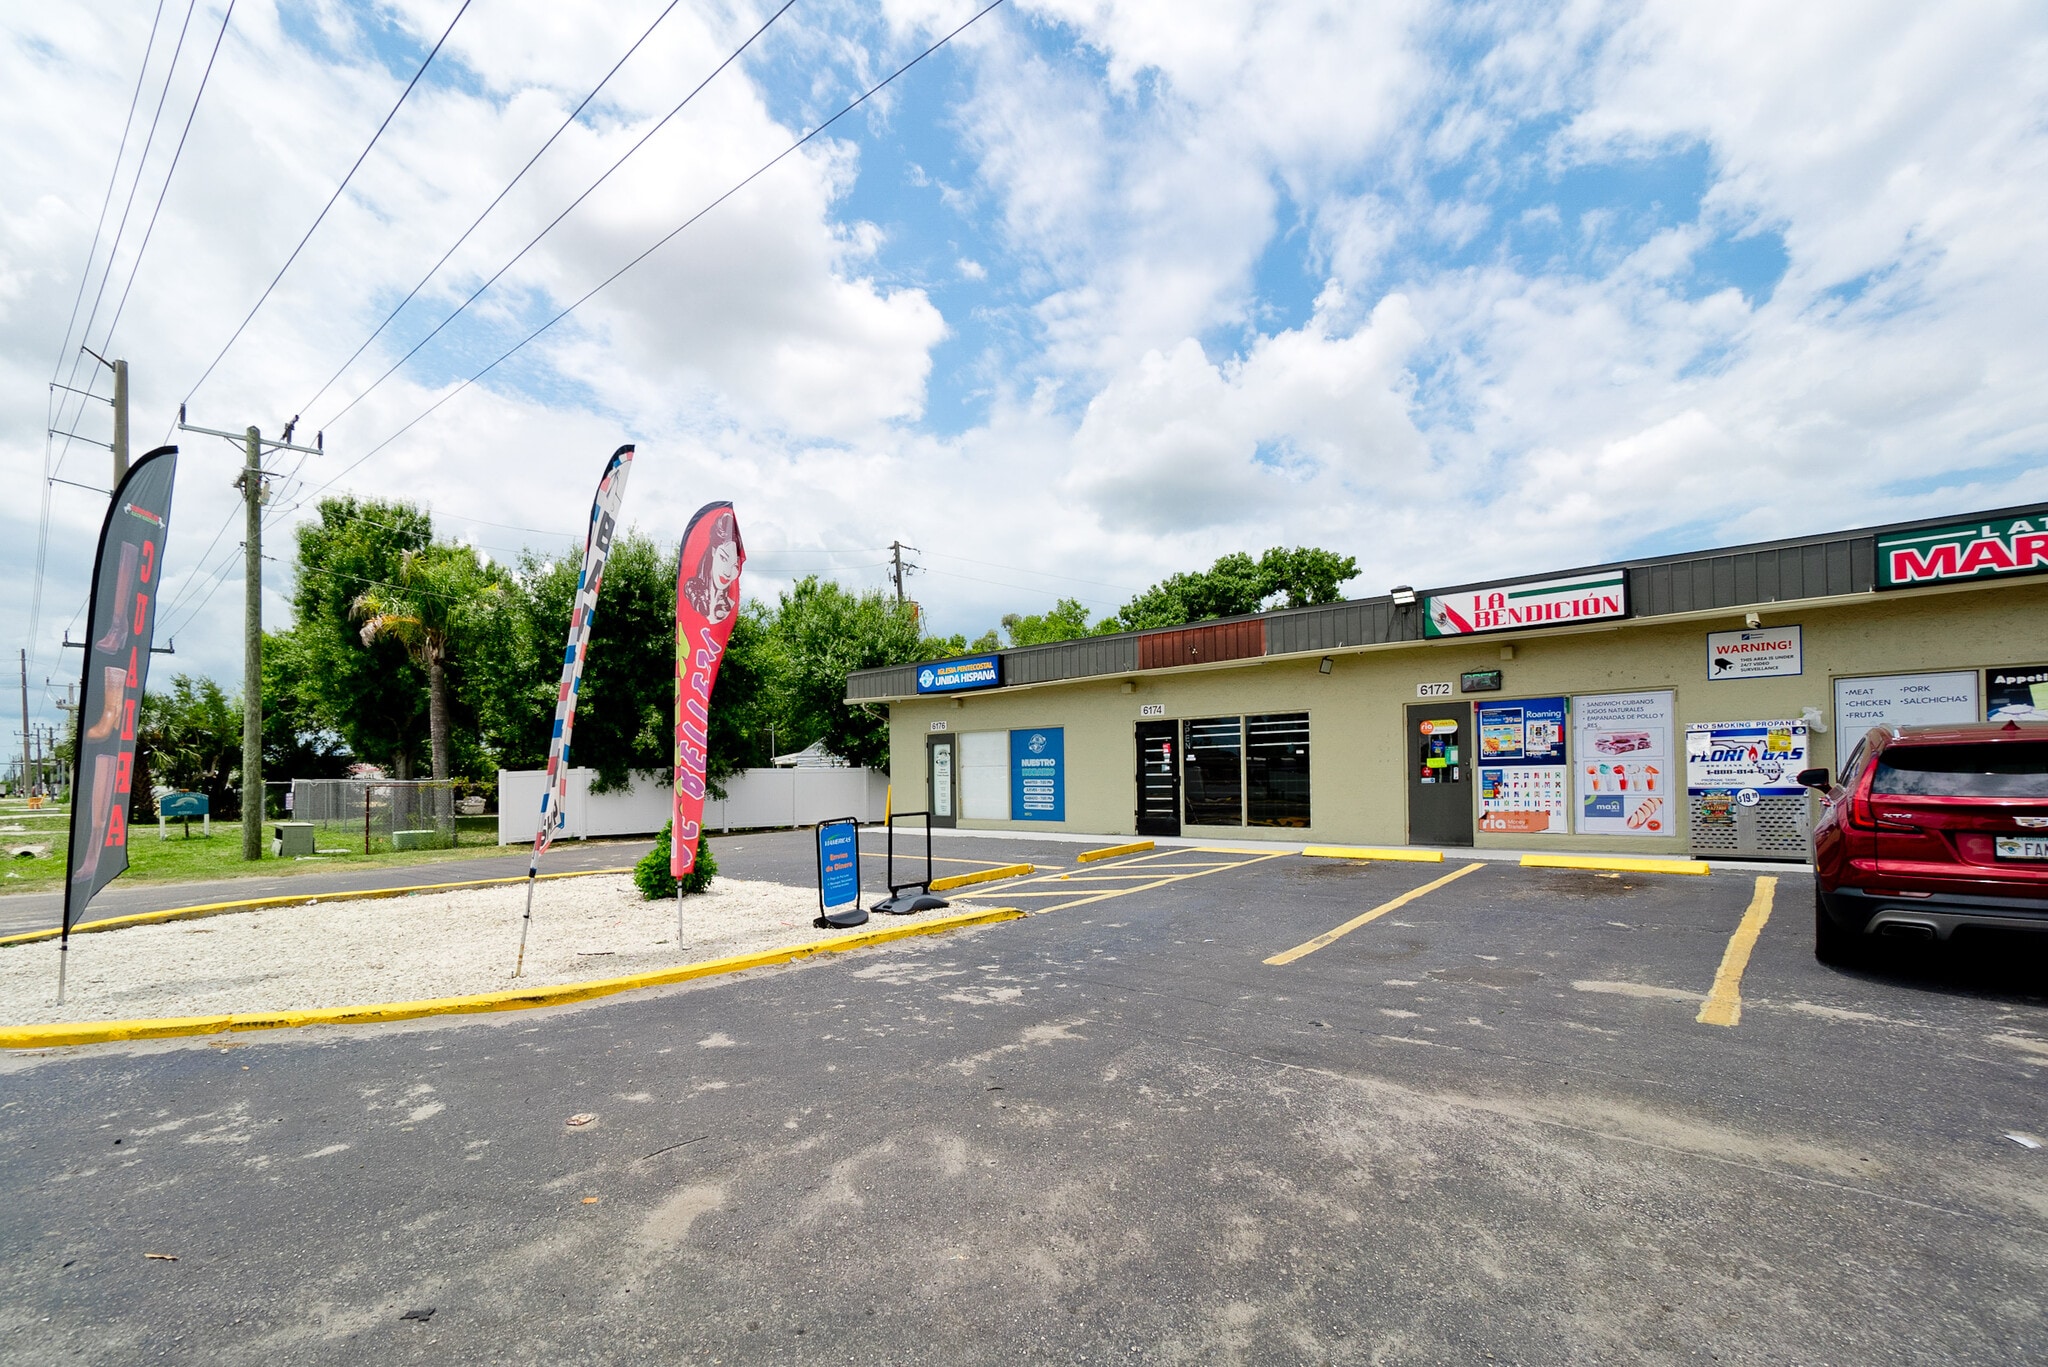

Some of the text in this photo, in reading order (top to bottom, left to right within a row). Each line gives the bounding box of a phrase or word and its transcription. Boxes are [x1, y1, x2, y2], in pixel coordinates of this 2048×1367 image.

[1474, 592, 1504, 611] LA
[1474, 593, 1619, 628] BENDICIÓN
[1716, 640, 1792, 655] WARNING!
[937, 661, 993, 675] IGLESIA PENTECOSTAL
[935, 669, 996, 686] UNIDA HISPANA
[1420, 683, 1450, 695] 6172
[1848, 685, 1931, 696] MEAT PORK
[1586, 699, 1654, 708] SANDWICH CUBANOS
[1848, 695, 1968, 708] CHICKEN SALCHICHAS
[1143, 705, 1162, 715] 6174
[1526, 710, 1562, 719] Roaming
[1608, 706, 1645, 714] NATURALES
[1849, 711, 1885, 719] FRUTAS
[1586, 714, 1626, 722] EMPANADAS
[931, 722, 946, 730] 6176
[1421, 722, 1433, 730] ria
[1756, 720, 1797, 728] PROPANE
[1761, 747, 1805, 761] GAS
[1021, 758, 1056, 767] NUESTRO
[1596, 802, 1620, 810] maxi
[1482, 814, 1507, 830] ria
